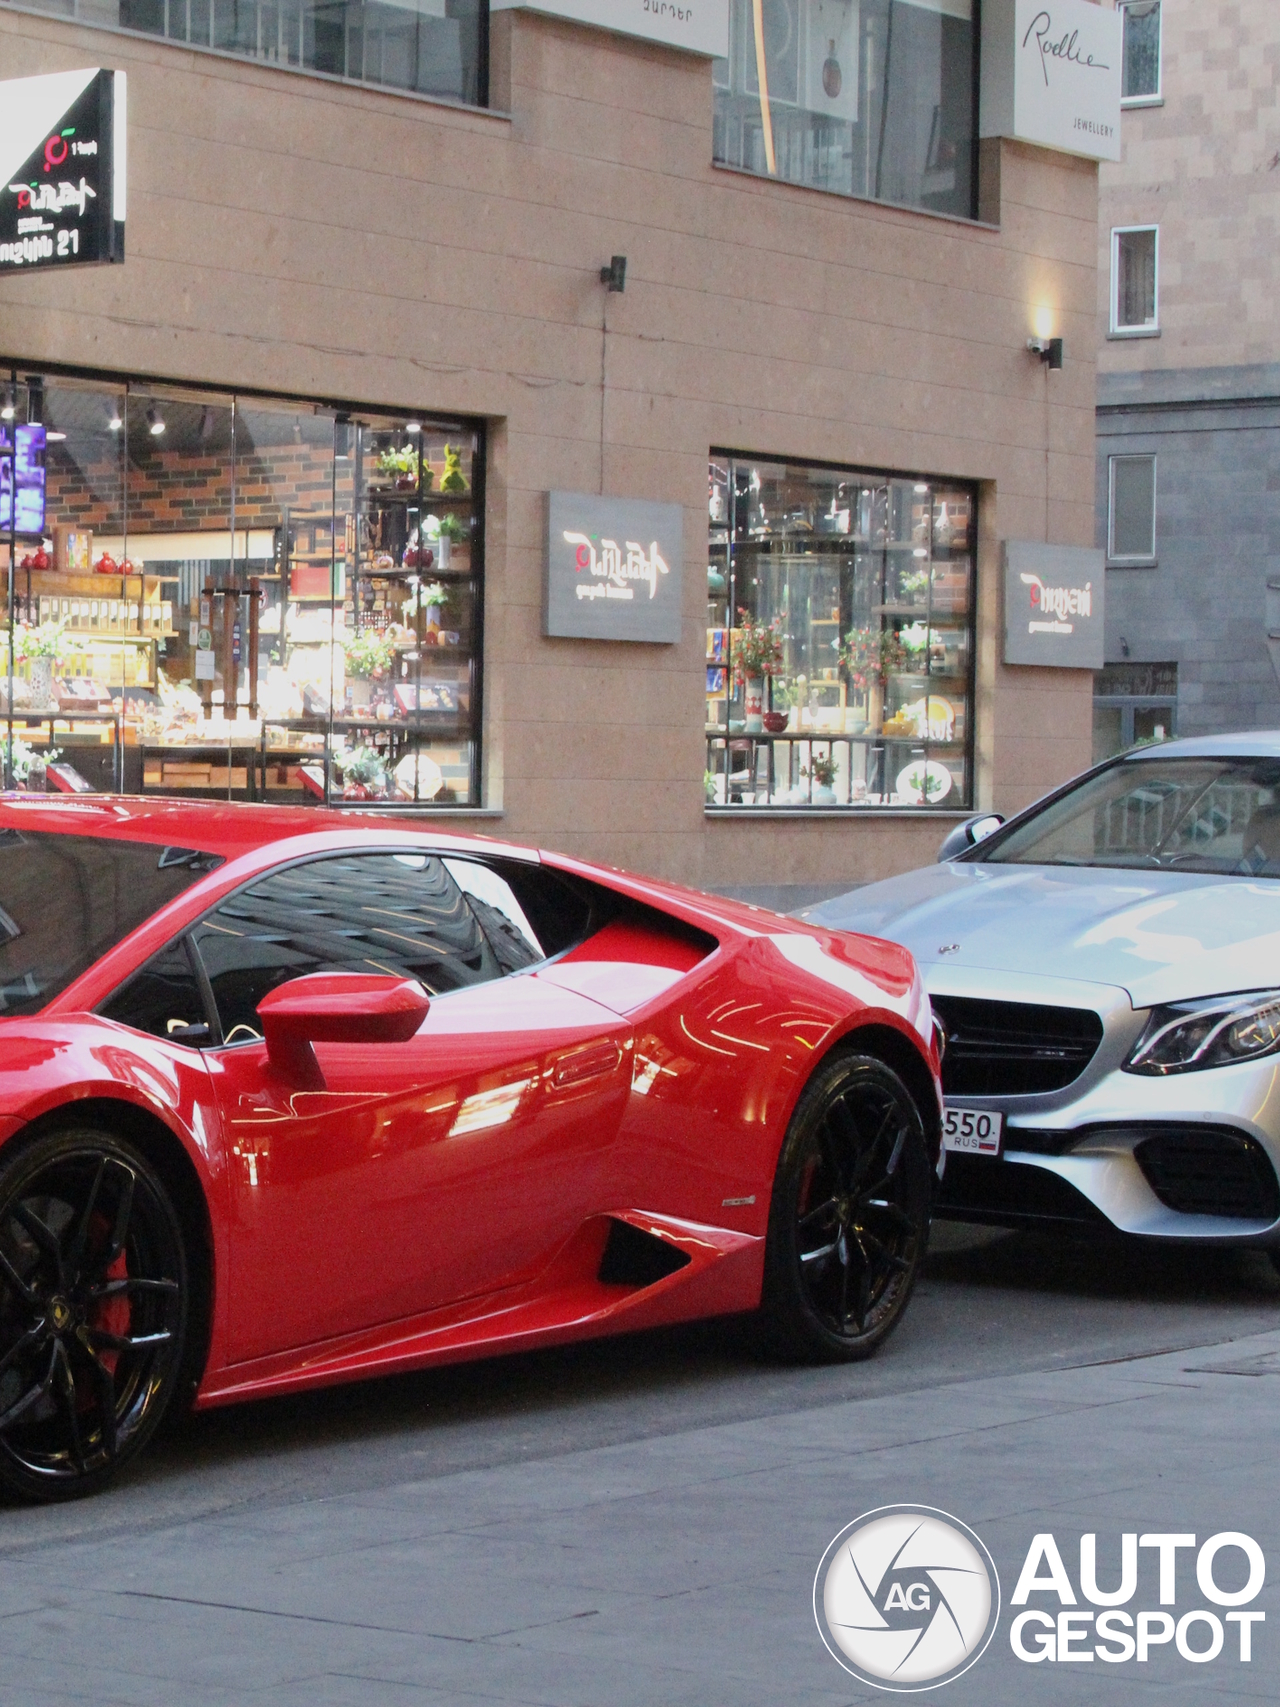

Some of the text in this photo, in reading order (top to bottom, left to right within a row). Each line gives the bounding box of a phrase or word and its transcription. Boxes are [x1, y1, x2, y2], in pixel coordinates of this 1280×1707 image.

[1073, 117, 1114, 138] JEWELLERY
[57, 228, 79, 256] 21
[944, 1110, 991, 1138] 550
[954, 1137, 978, 1148] RUS
